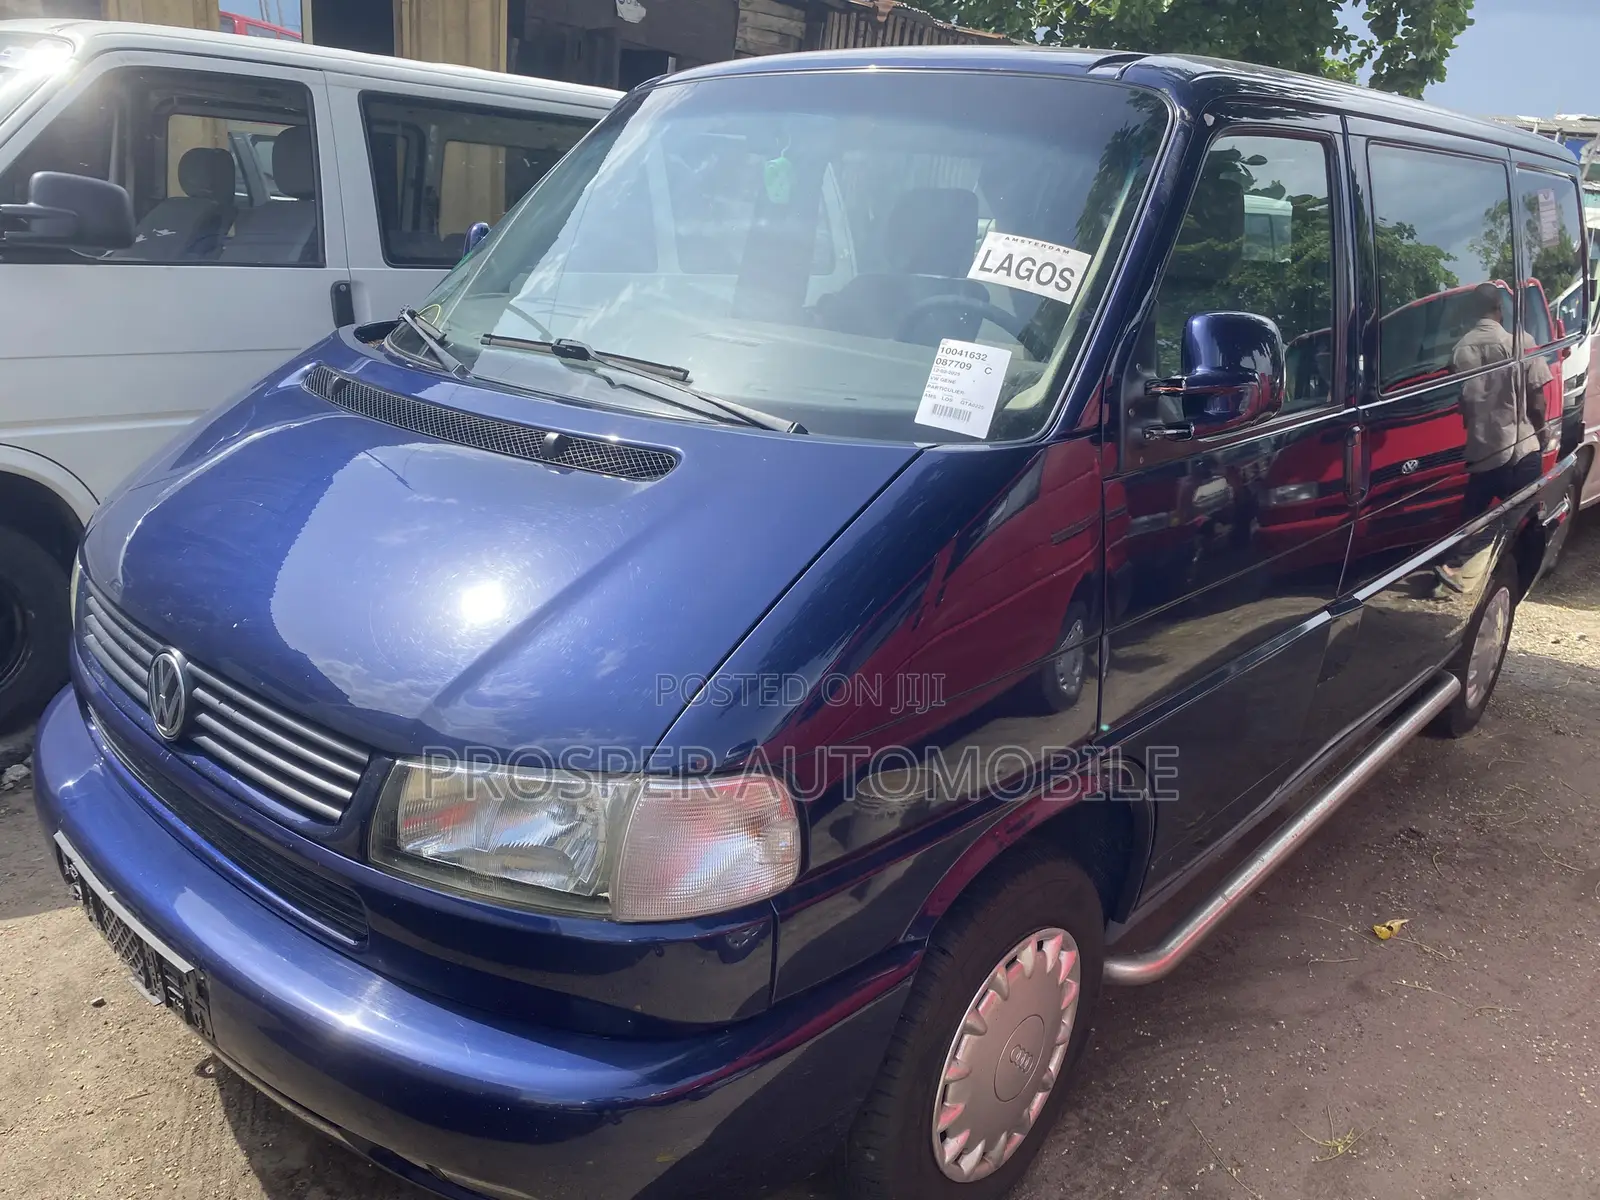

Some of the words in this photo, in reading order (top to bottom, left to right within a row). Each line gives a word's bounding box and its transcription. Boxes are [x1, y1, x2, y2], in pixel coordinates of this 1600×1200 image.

[1004, 236, 1070, 255] AMSTERDAM
[978, 249, 1075, 292] LAGOS
[940, 346, 988, 362] 10041632
[935, 357, 972, 371] 087709
[984, 366, 993, 375] C
[926, 384, 965, 396] PARTICULIER
